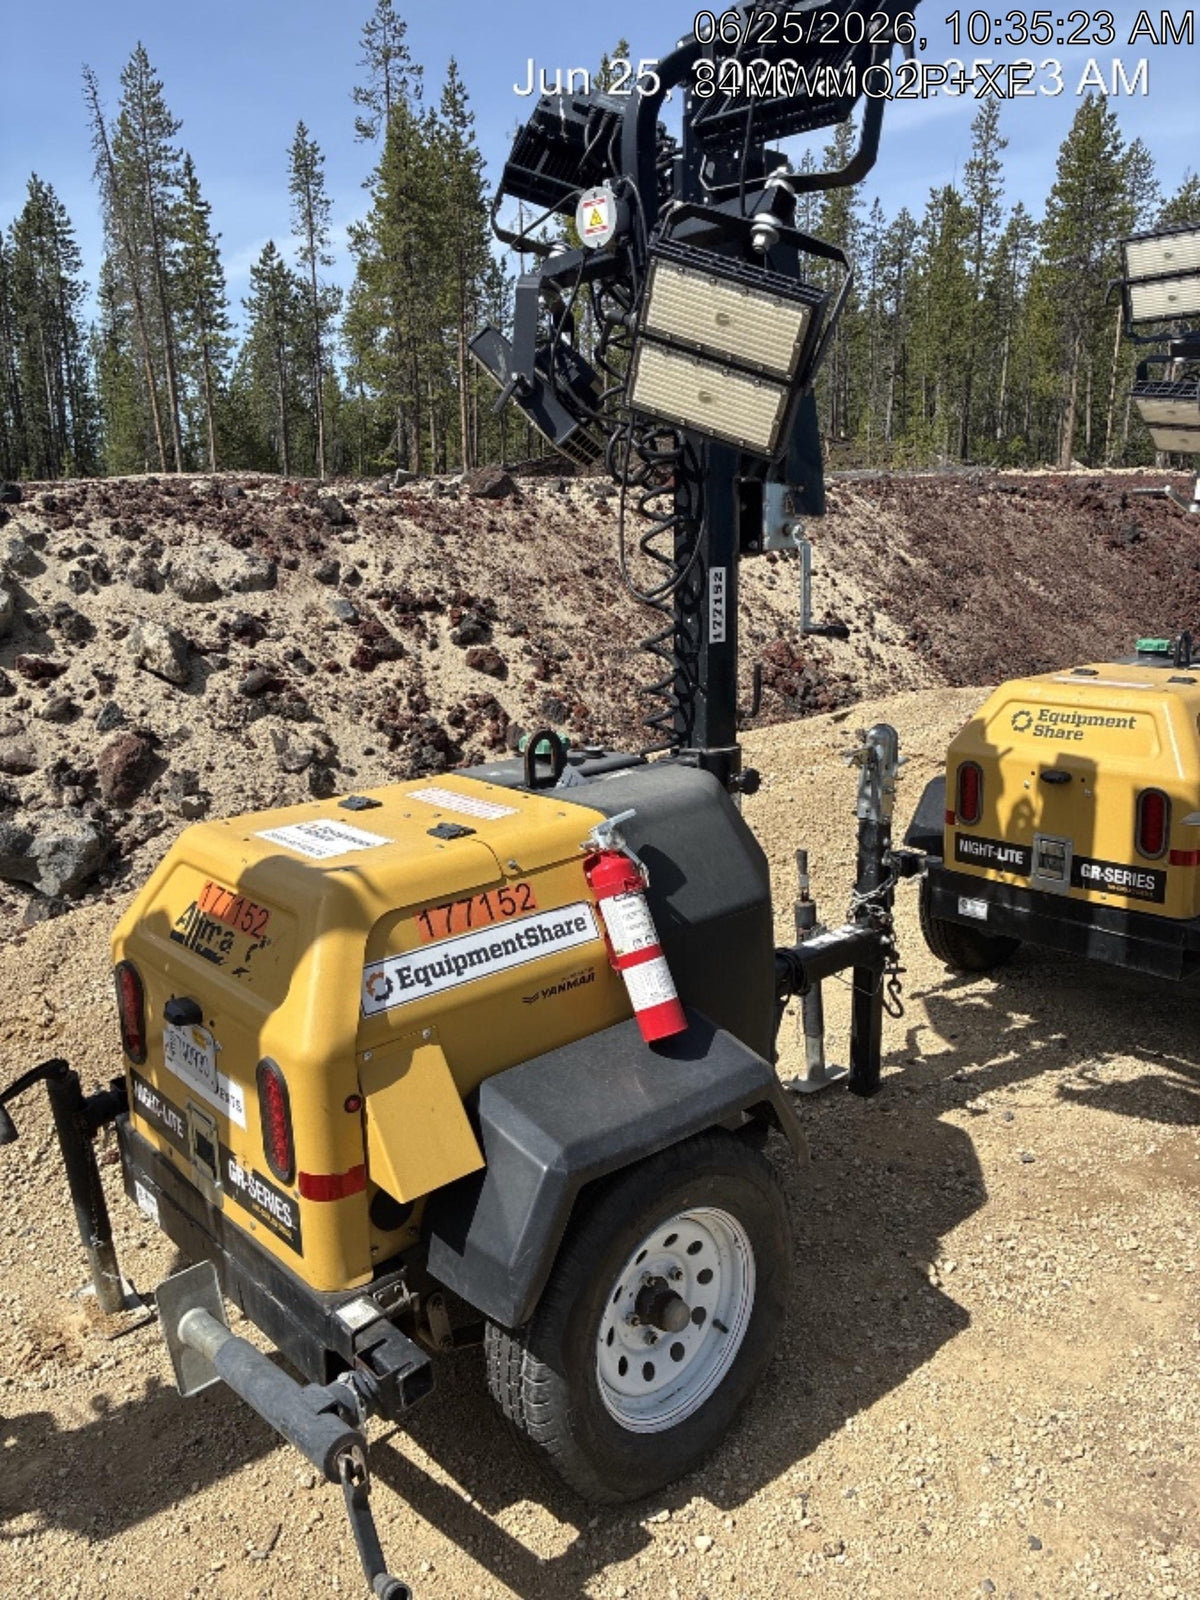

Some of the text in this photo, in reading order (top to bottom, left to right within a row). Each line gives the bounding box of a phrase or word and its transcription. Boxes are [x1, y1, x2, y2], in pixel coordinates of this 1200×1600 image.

[1032, 724, 1084, 741] Share
[1037, 709, 1137, 730] Equipment
[959, 839, 1024, 866] NIGHT-LITE
[1081, 863, 1155, 890] GR-SERIES
[202, 881, 270, 940] 177152
[418, 883, 537, 938] 177152
[397, 915, 587, 992] EquipmentShare
[134, 1080, 184, 1139] NIGHT-LITE
[228, 1158, 292, 1228] GR-SERIES
